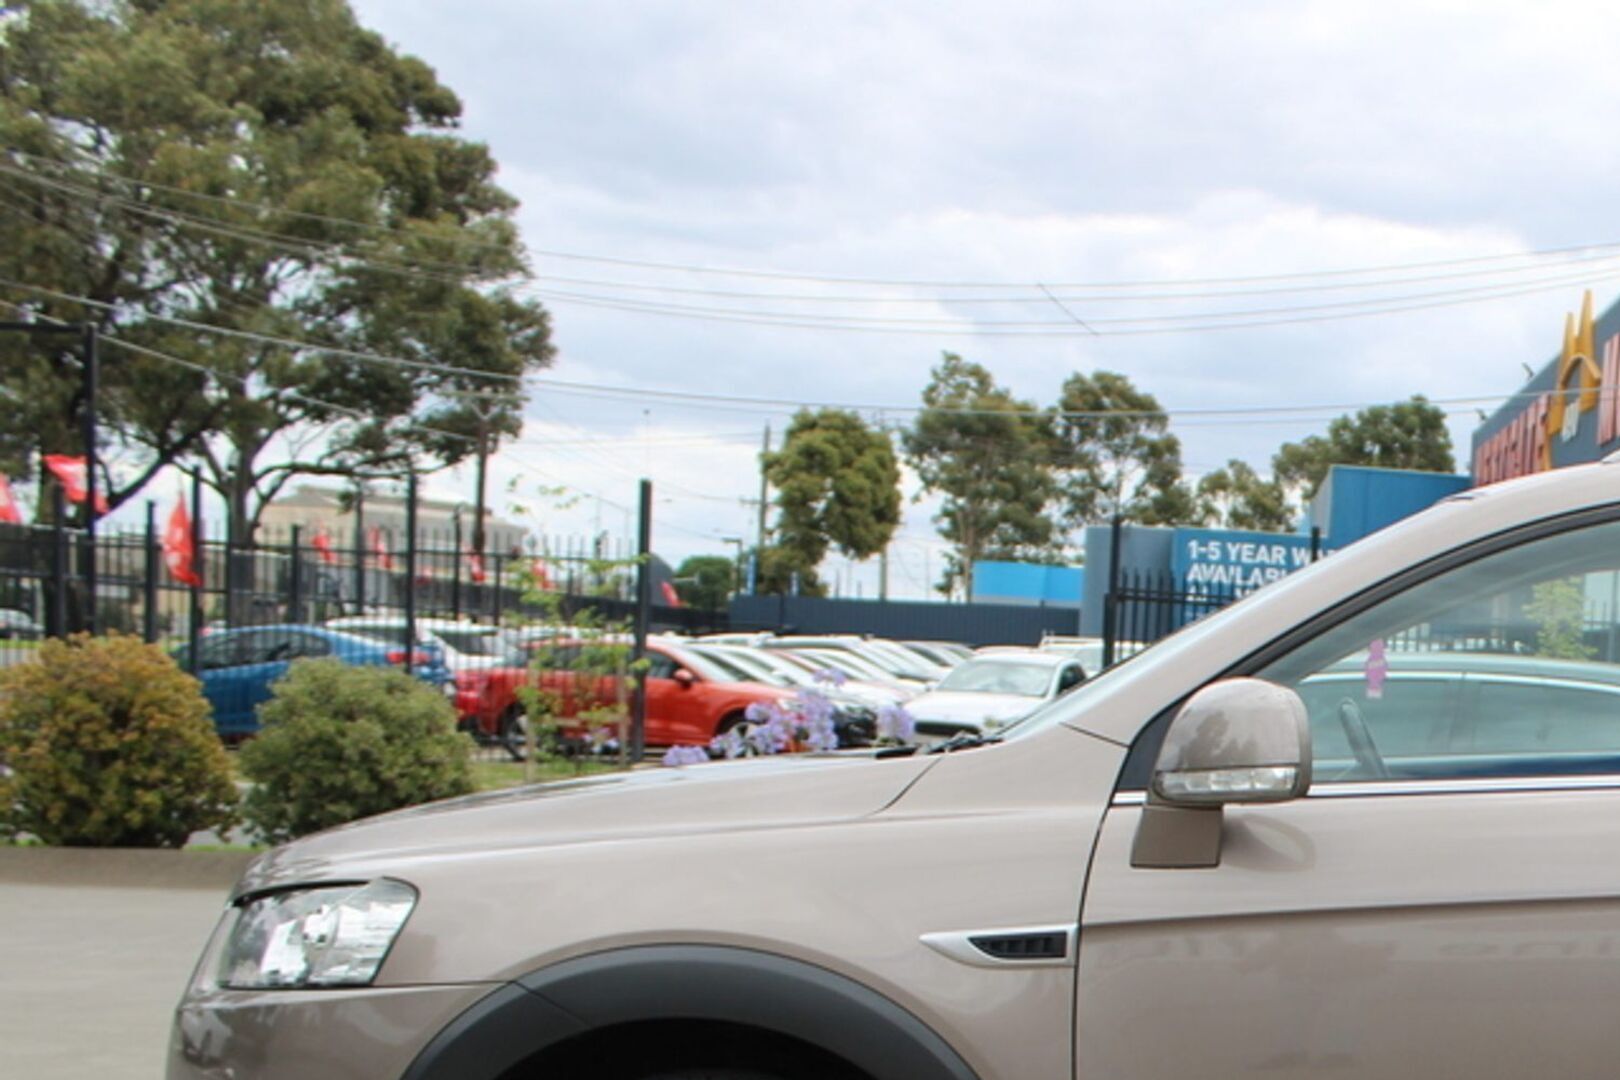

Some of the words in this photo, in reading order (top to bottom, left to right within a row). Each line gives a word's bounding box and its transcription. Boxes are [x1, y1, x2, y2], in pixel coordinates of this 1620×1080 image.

[1188, 540, 1222, 561] 1-5
[1226, 542, 1287, 566] YEAR
[1186, 562, 1288, 588] AVAILAB
